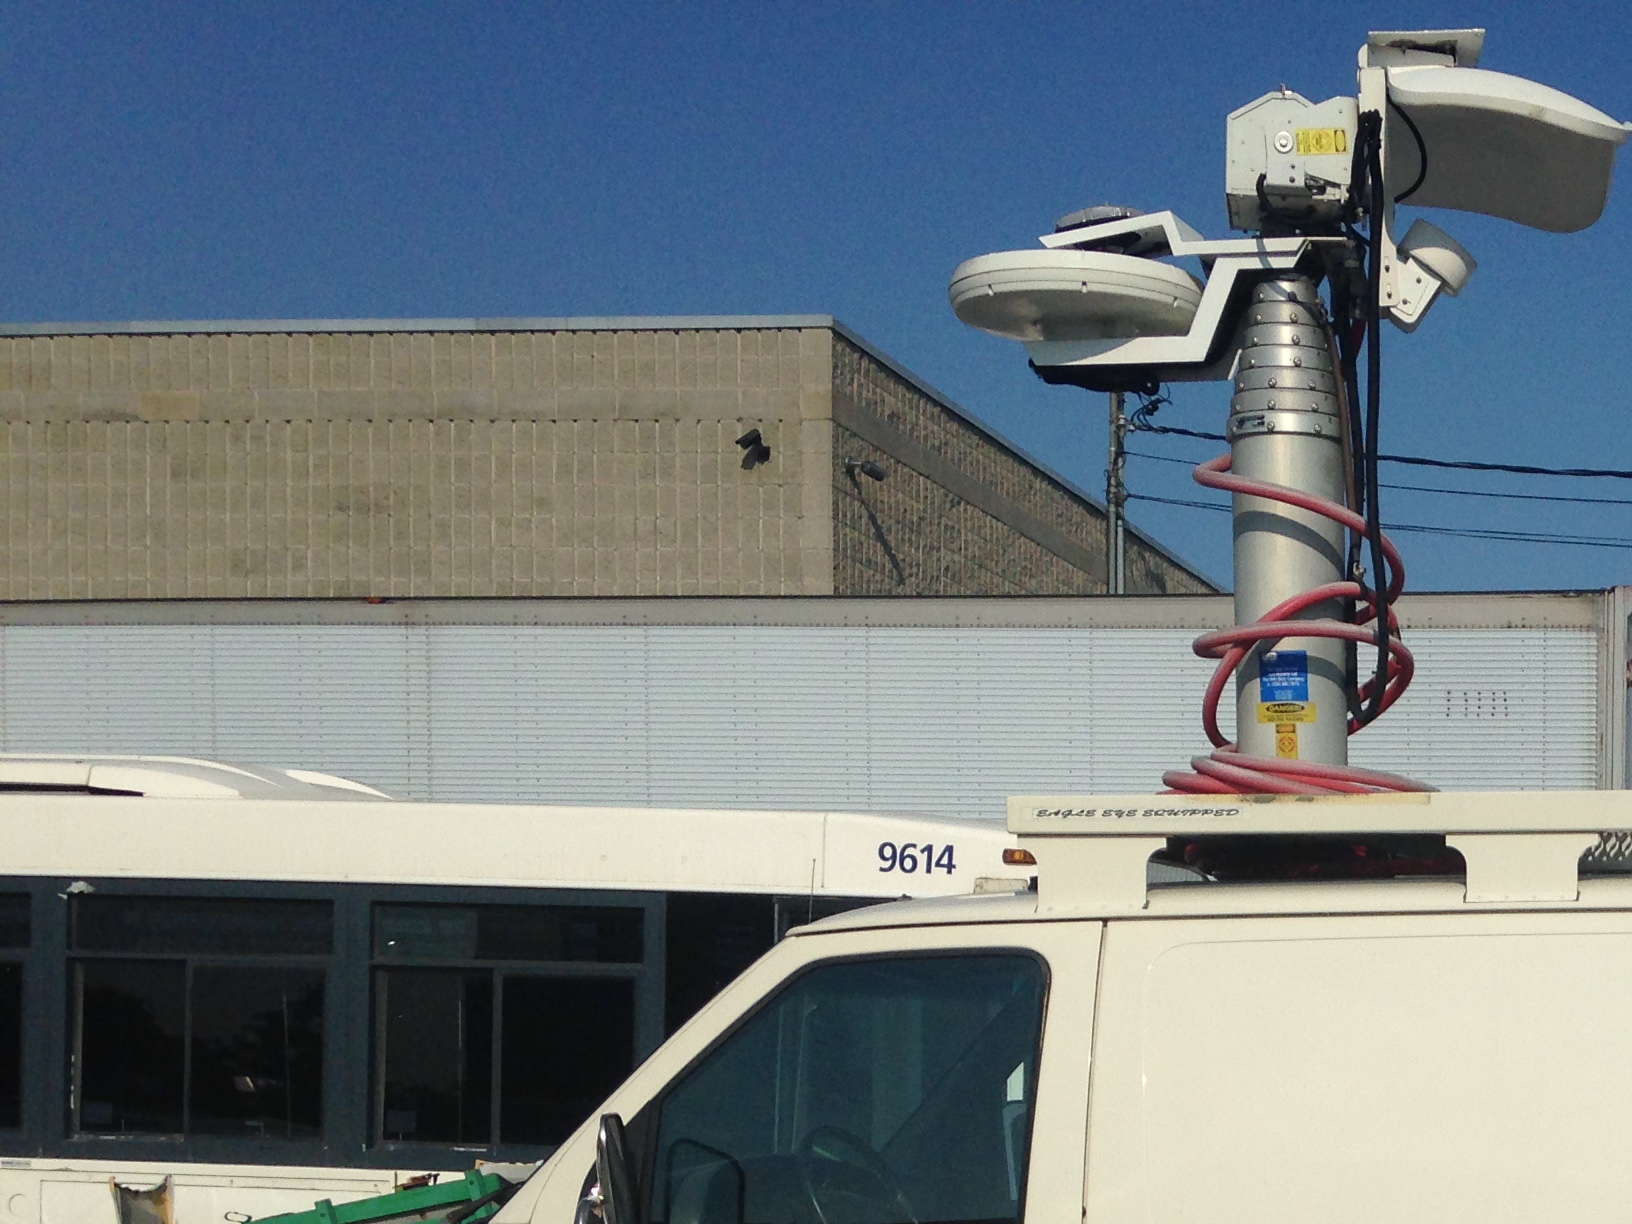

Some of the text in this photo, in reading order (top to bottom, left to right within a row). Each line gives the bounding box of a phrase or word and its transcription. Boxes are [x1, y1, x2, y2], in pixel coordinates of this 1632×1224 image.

[1036, 808, 1240, 819] EAGLE EYE EQUIPPED
[878, 841, 957, 875] 9614
